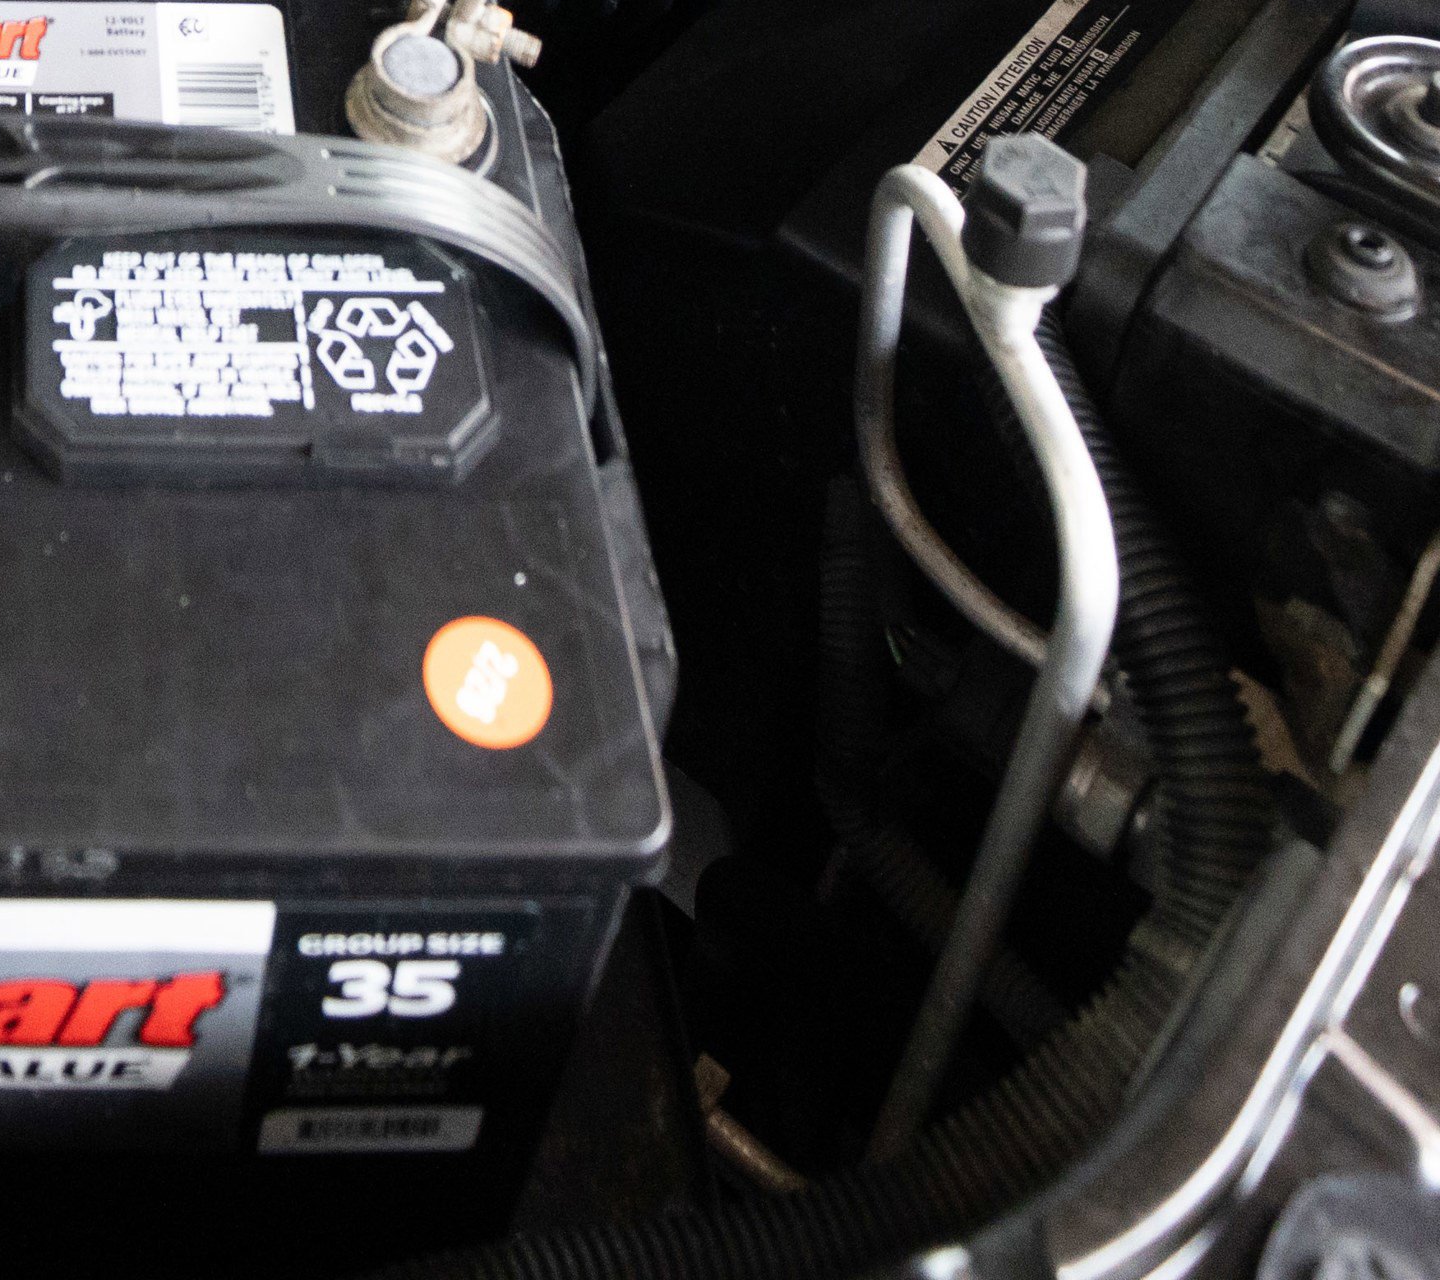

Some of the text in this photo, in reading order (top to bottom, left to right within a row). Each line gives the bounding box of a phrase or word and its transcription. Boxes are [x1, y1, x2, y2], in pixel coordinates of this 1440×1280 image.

[106, 27, 146, 38] Battery
[1085, 78, 1100, 91] LA
[1094, 30, 1141, 78] TRANSMISSION
[950, 92, 998, 139] CAUTION
[994, 36, 1047, 91] ATTENTION
[1010, 90, 1045, 125] DAMAGE
[1042, 70, 1062, 89] THE
[1059, 15, 1111, 68] TRANSMISSION
[1033, 101, 1062, 132] LIQUIDE
[1055, 82, 1078, 106] MATIC
[1073, 59, 1099, 85] NISSAN
[949, 151, 972, 176] ONLY
[971, 130, 990, 150] USE
[988, 99, 1019, 130] NISSAN
[1016, 71, 1042, 99] MATIC
[1039, 46, 1064, 72] FLUID
[298, 932, 505, 956] GROUP SIZE
[322, 958, 462, 1019] 35
